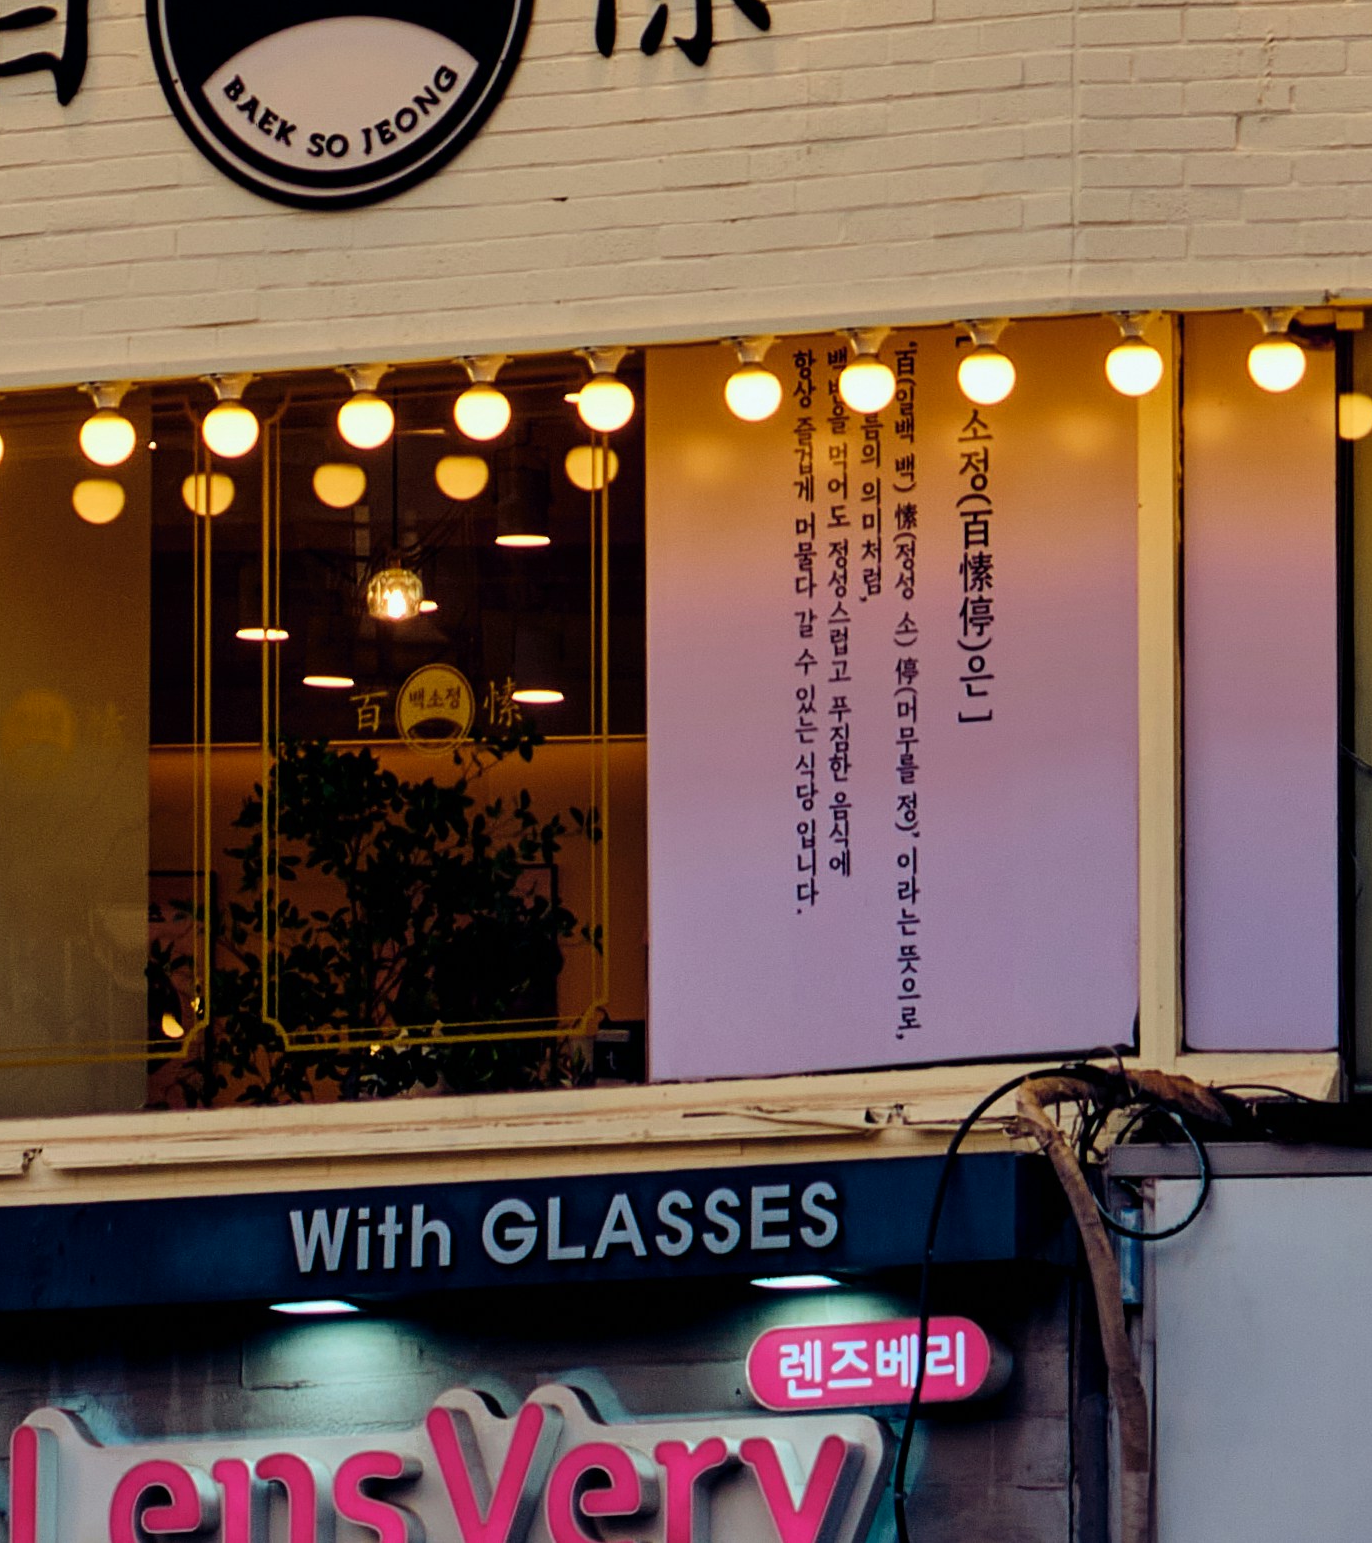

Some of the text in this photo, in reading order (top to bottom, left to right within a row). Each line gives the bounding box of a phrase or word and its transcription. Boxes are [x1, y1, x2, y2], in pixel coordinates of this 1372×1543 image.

[223, 65, 459, 158] BAEK SO JEONG
[409, 685, 462, 711] 백소정
[289, 1180, 839, 1272] With GLASSES
[778, 1331, 966, 1399] 렌즈베리
